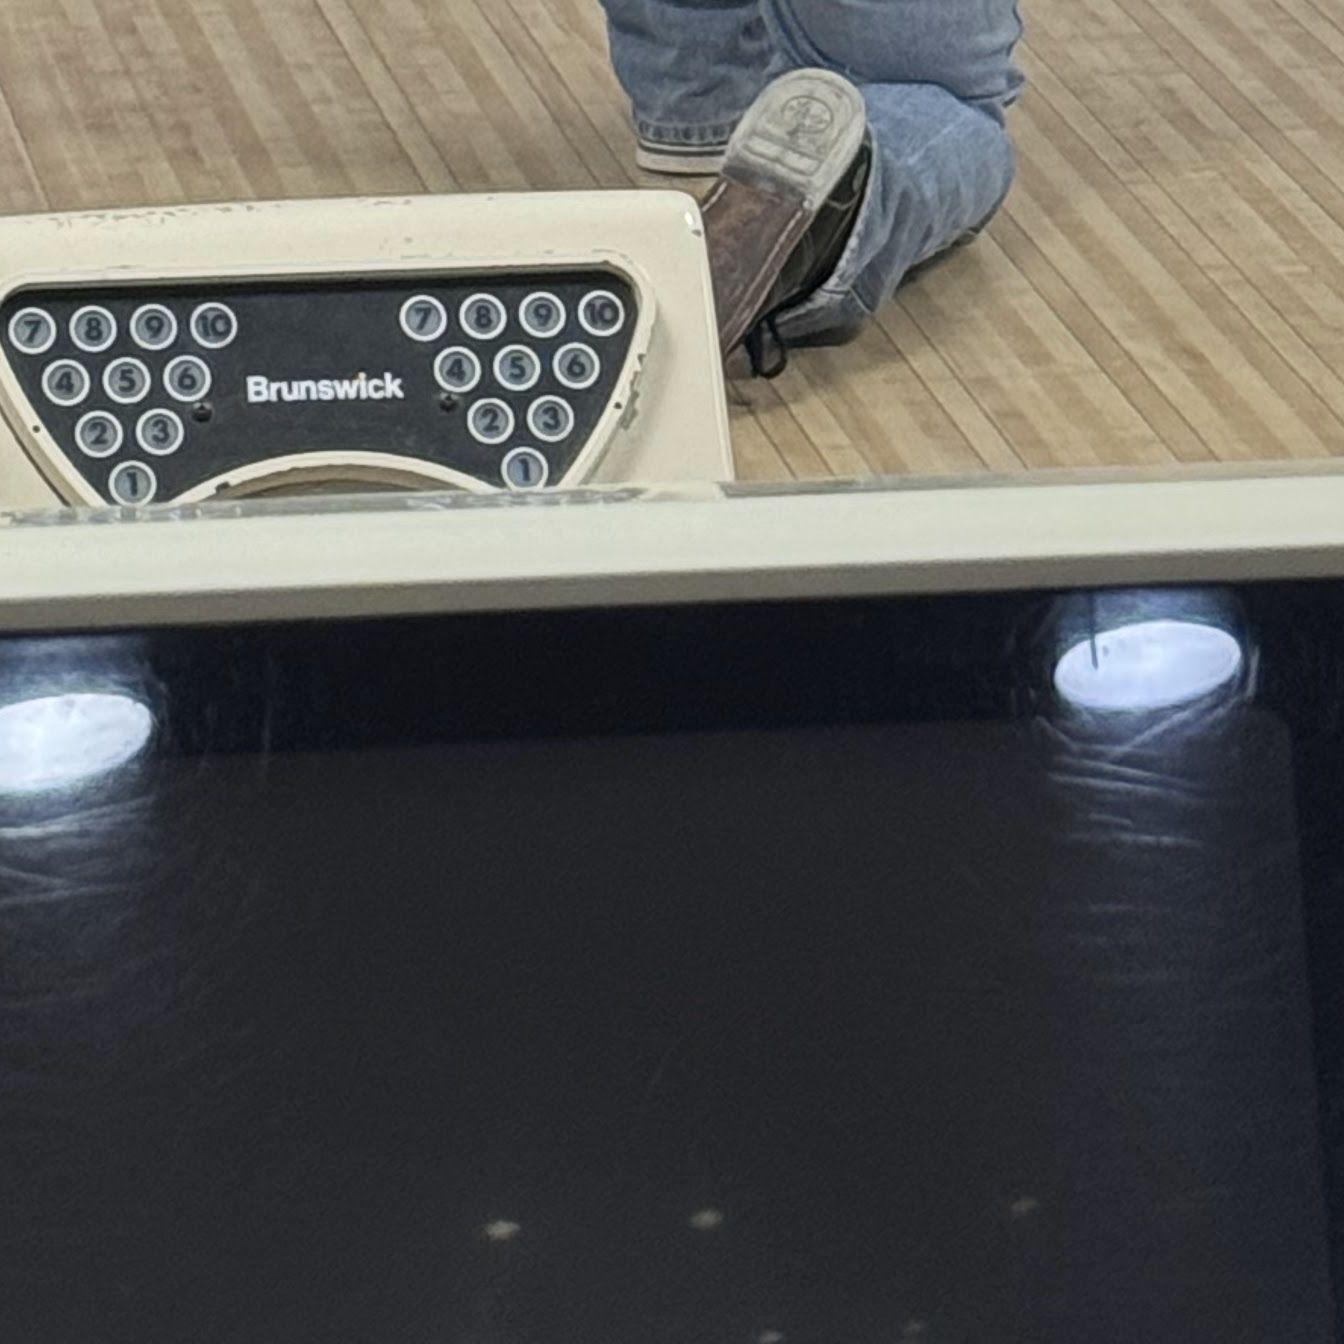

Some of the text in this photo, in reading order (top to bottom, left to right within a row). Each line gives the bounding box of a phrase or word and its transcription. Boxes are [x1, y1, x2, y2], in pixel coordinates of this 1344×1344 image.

[23, 313, 232, 343] 7 8 9 10
[414, 301, 619, 331] 7 8 9 10
[54, 366, 197, 394] 4 5 6
[445, 354, 587, 382] 4 5 6
[246, 372, 405, 402] Brunswick
[89, 418, 171, 445] 2 3
[480, 406, 562, 432] 2 3
